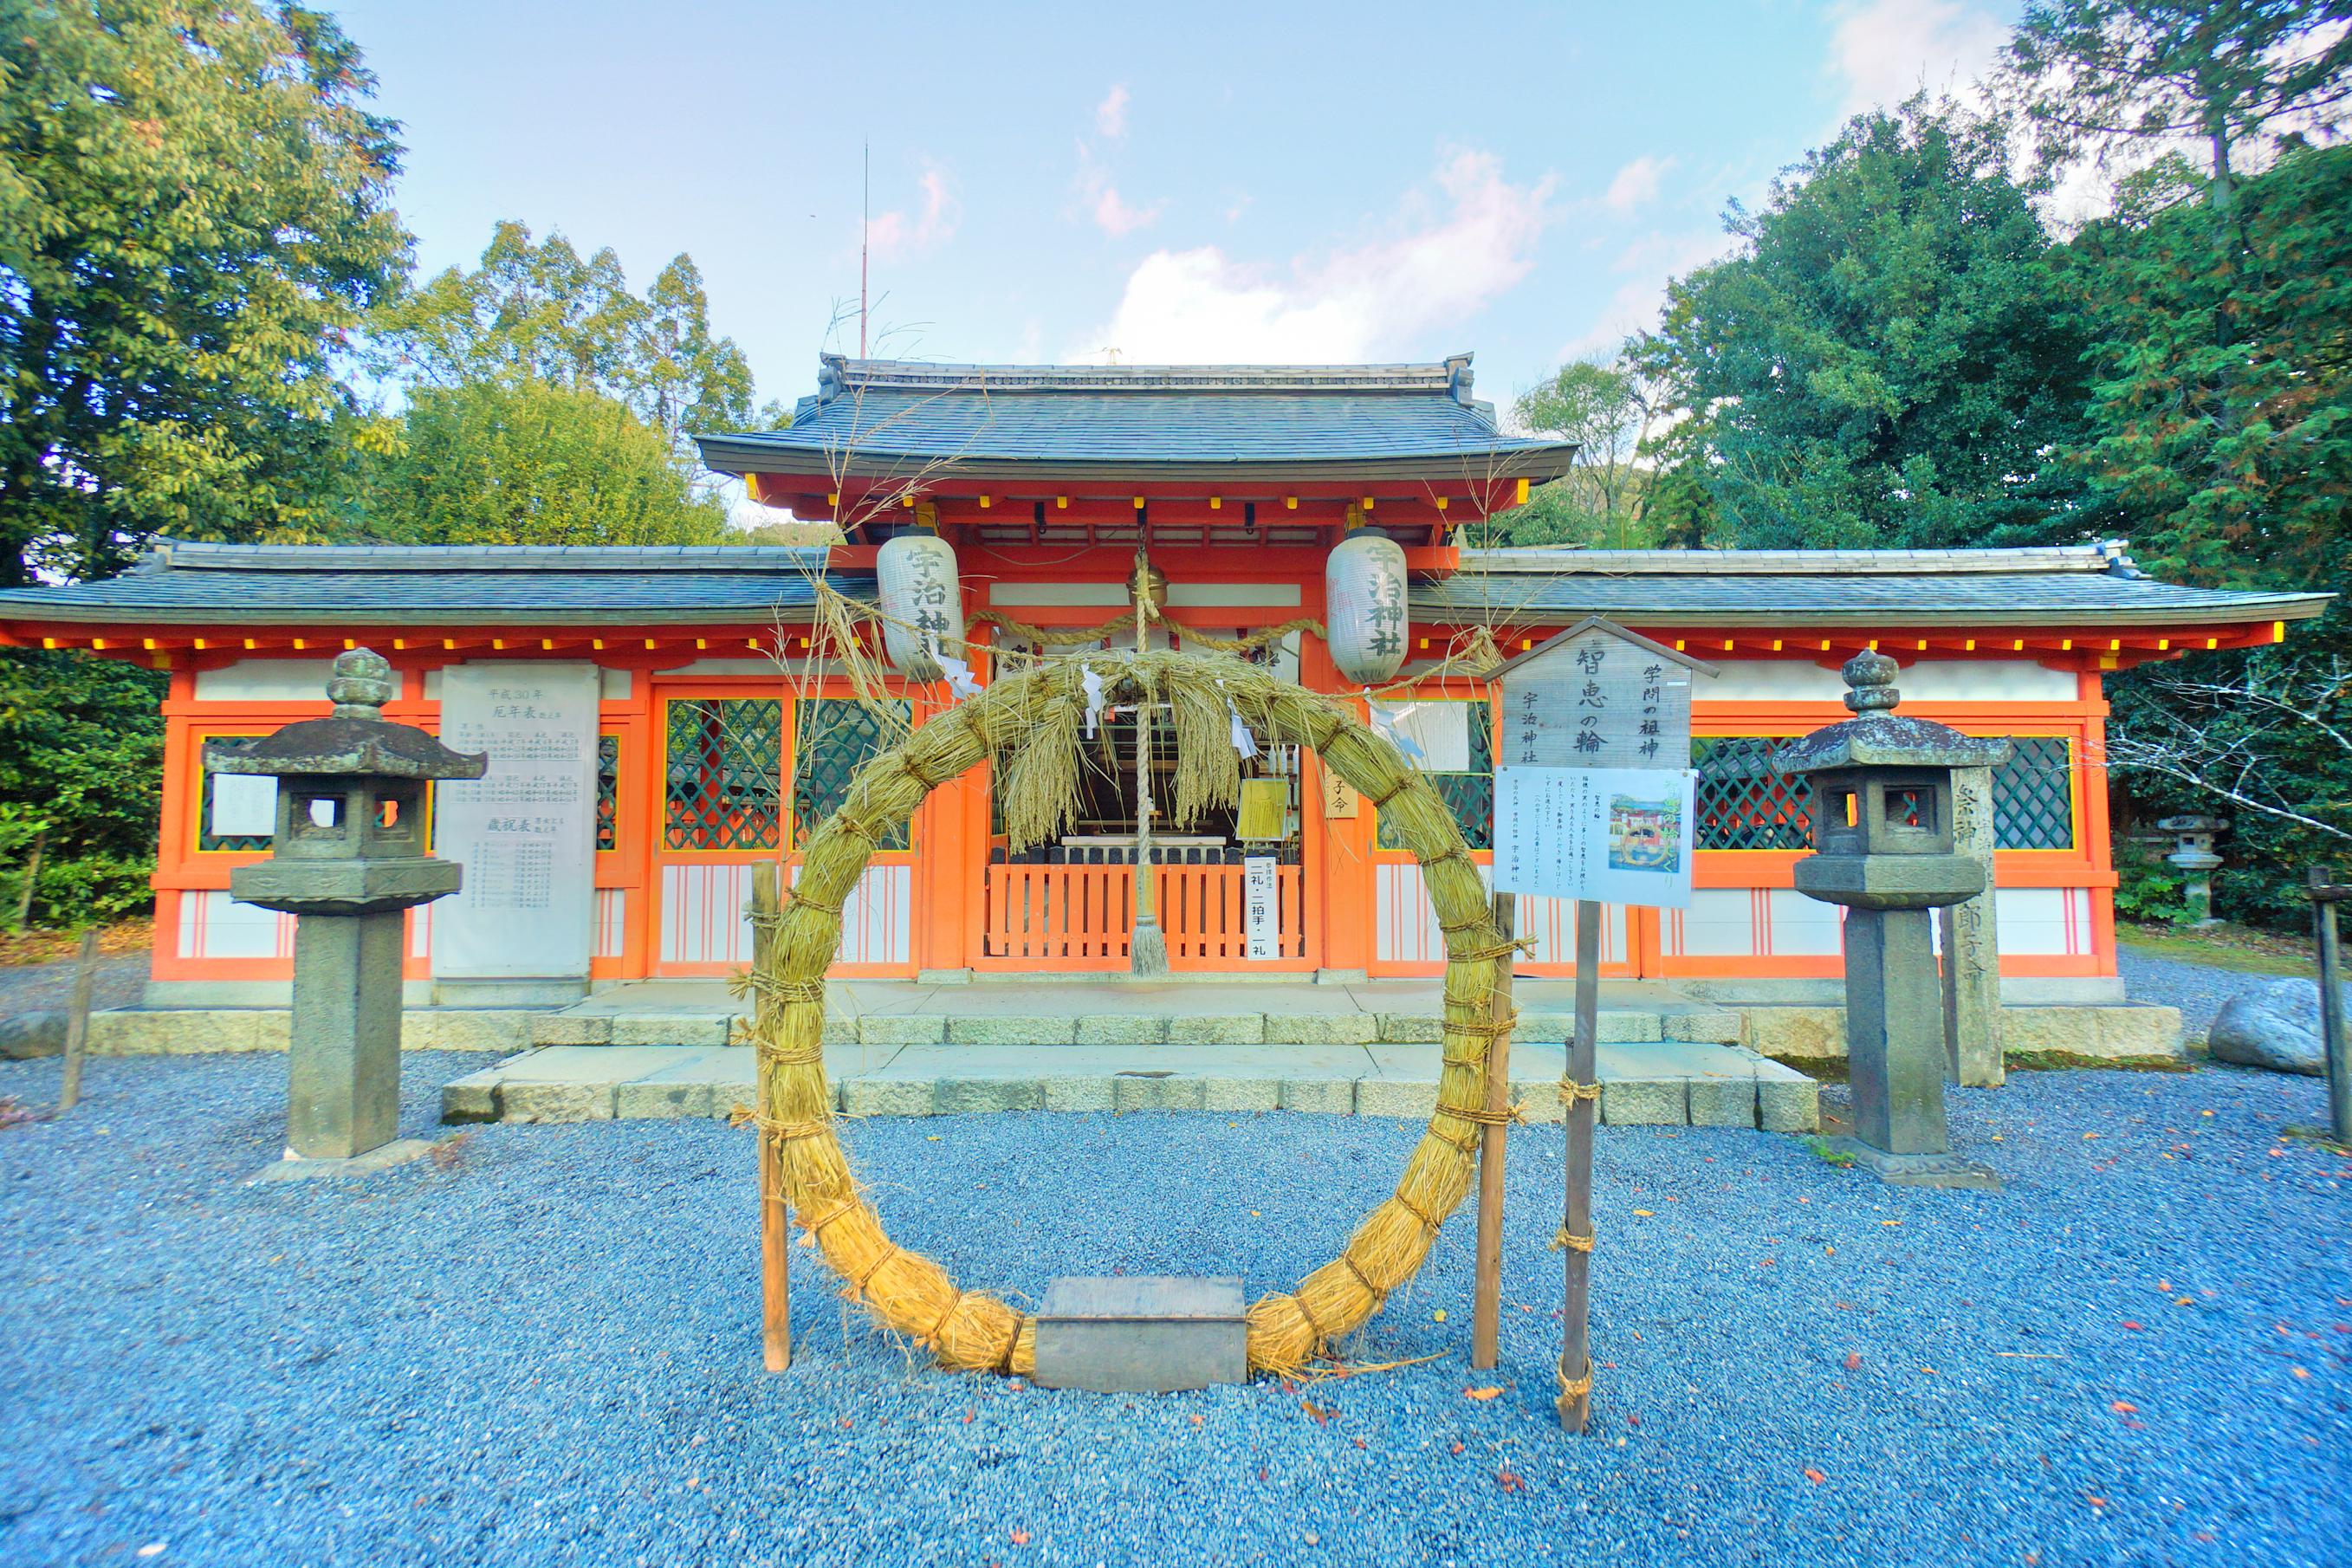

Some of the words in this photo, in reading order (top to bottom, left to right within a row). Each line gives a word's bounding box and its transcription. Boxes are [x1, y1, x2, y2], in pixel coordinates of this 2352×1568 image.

[1365, 542, 1403, 657] 宇治神社
[489, 688, 544, 700] 平成30年
[492, 705, 536, 719] 厄年表
[1520, 690, 1539, 764] 宇治神社
[1572, 649, 1609, 755] 智恵の輪
[1638, 663, 1662, 761] 学問の祖神
[1331, 780, 1349, 813] 子命
[1511, 844, 1519, 883] 宇治神社
[1250, 865, 1267, 956] 二礼・二拍手・一礼
